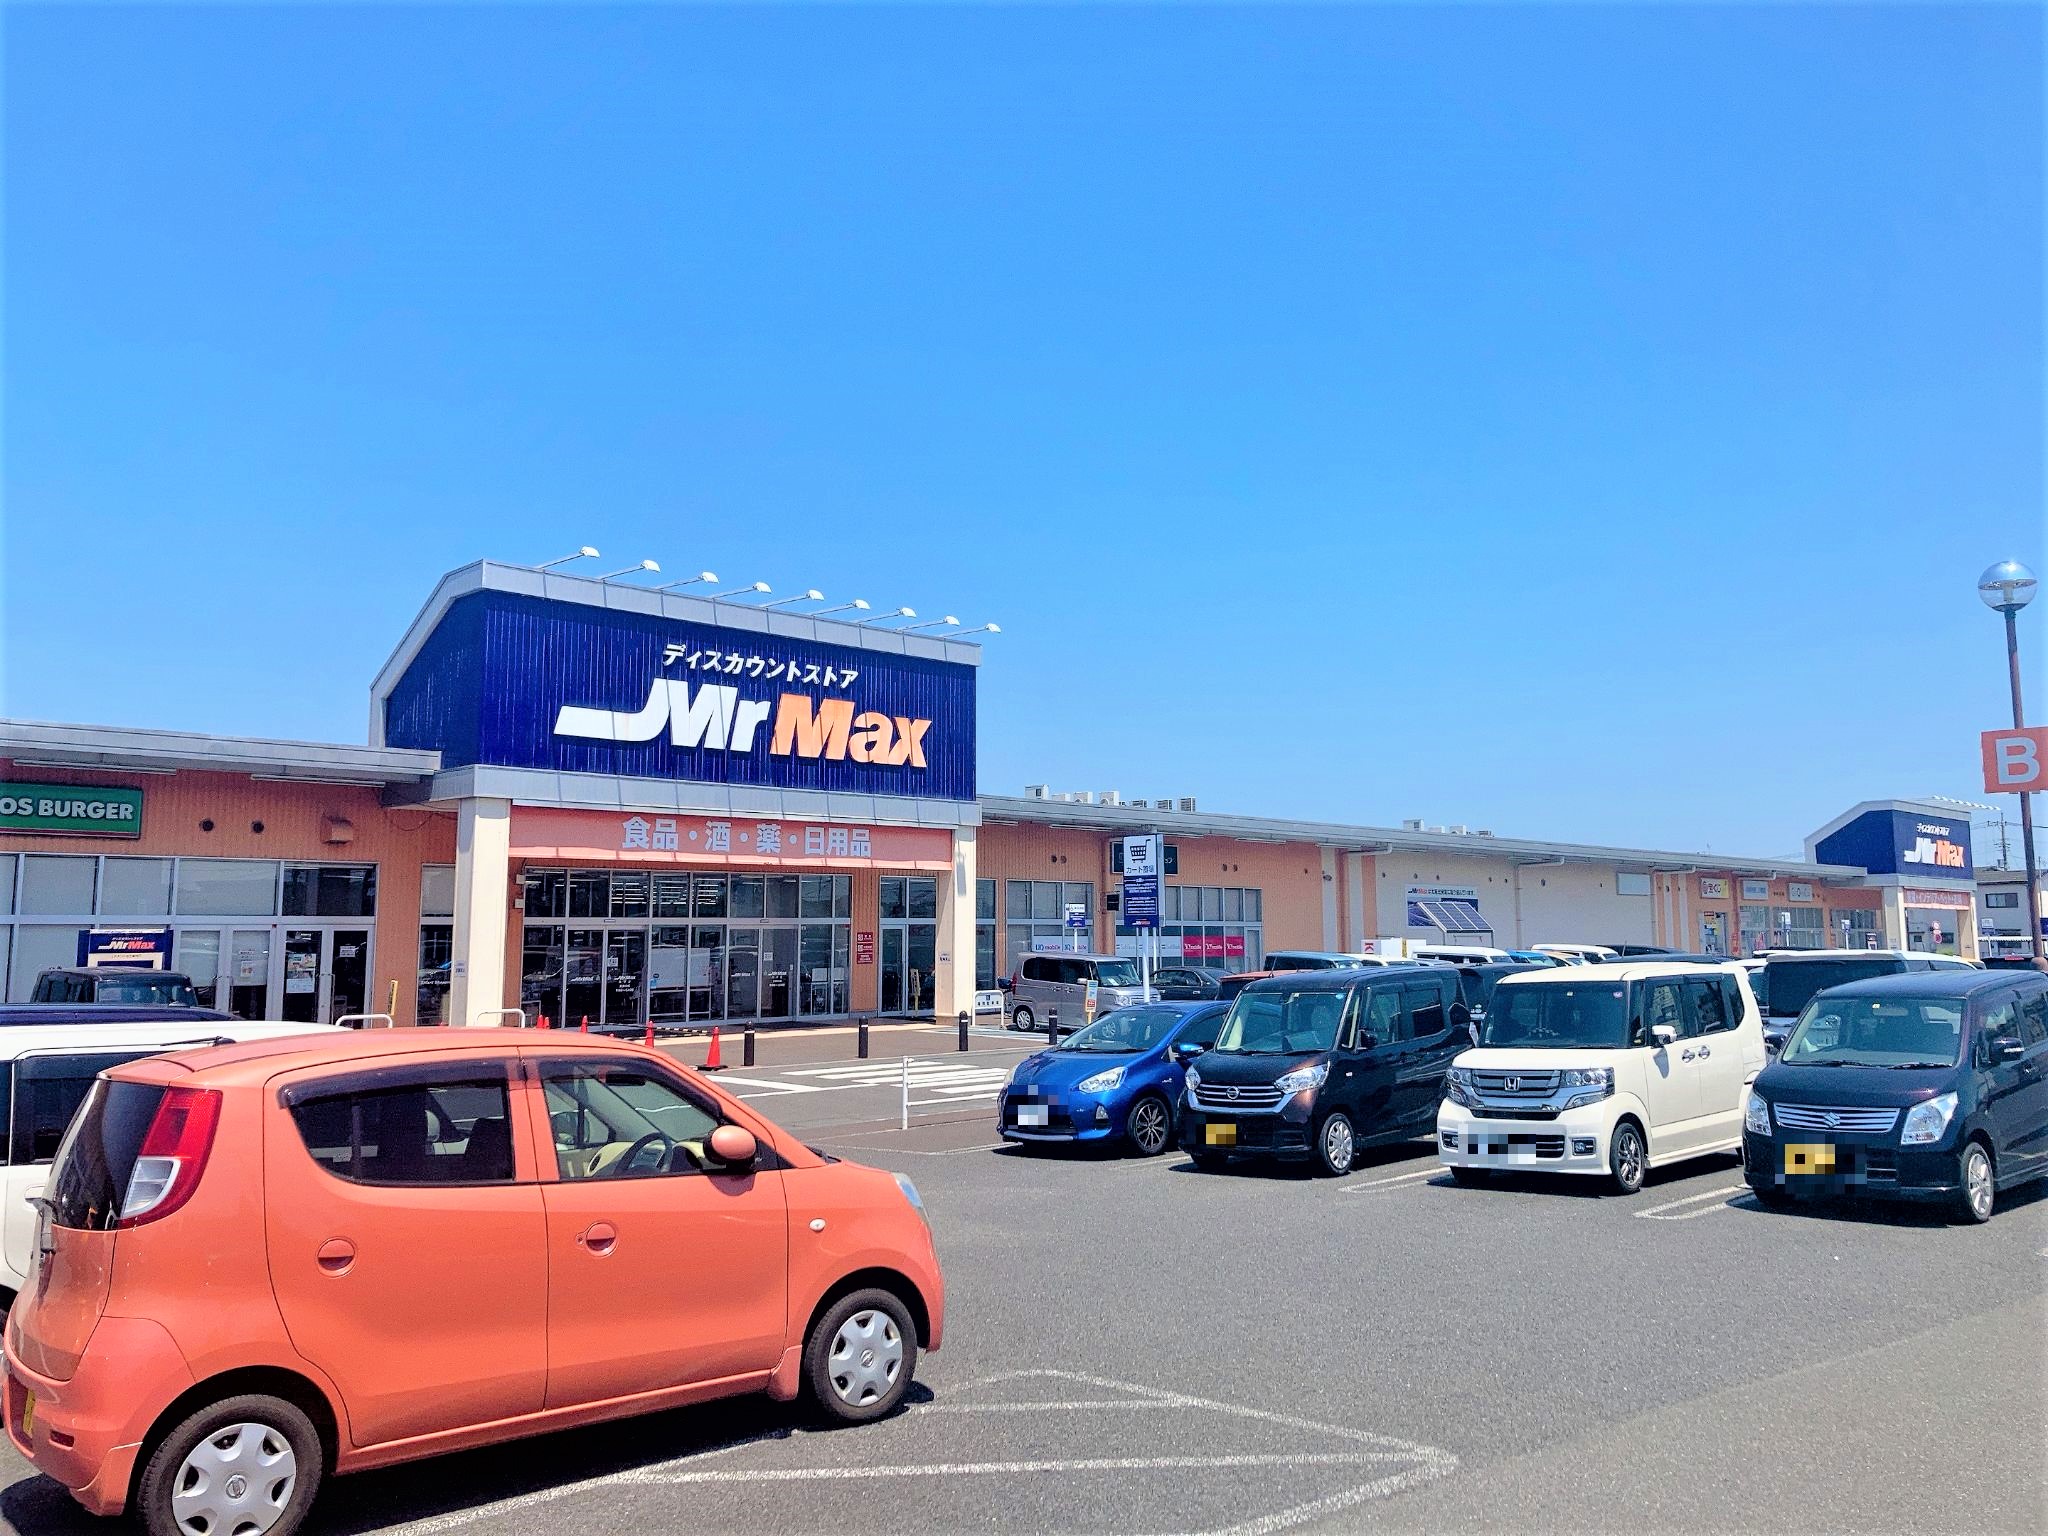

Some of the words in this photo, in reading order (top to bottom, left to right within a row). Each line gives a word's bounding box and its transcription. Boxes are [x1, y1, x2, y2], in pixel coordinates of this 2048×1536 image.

[662, 643, 859, 689] ディスカウントストア
[1995, 736, 2041, 786] B
[38, 799, 134, 820] BURGER
[621, 816, 872, 859] 食品・酒・薬・日用品
